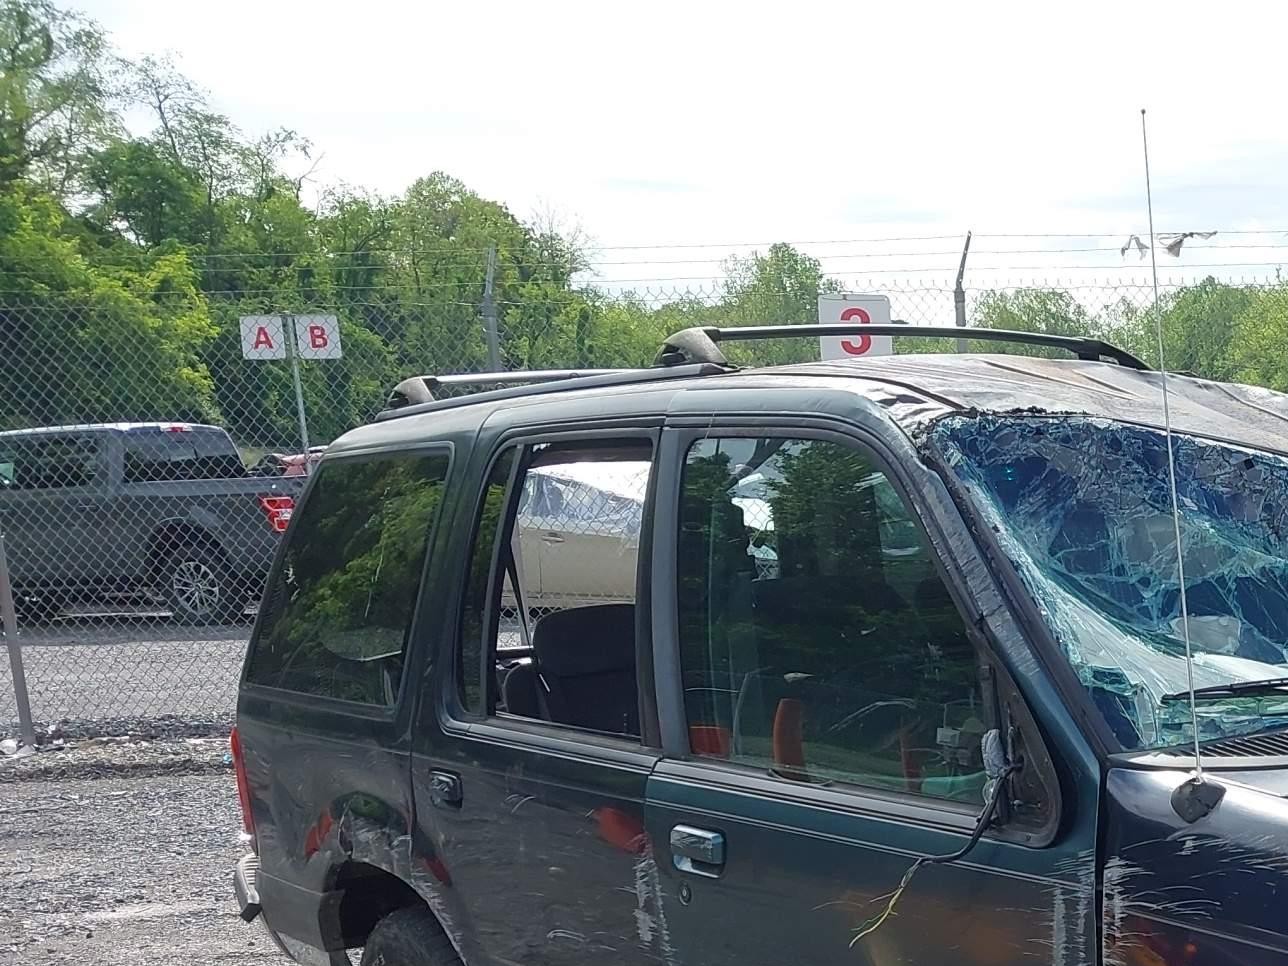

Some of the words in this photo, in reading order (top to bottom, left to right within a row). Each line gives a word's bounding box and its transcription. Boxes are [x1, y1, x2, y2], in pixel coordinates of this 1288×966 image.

[254, 326, 274, 349] A
[309, 325, 328, 349] B
[840, 307, 872, 356] 3
